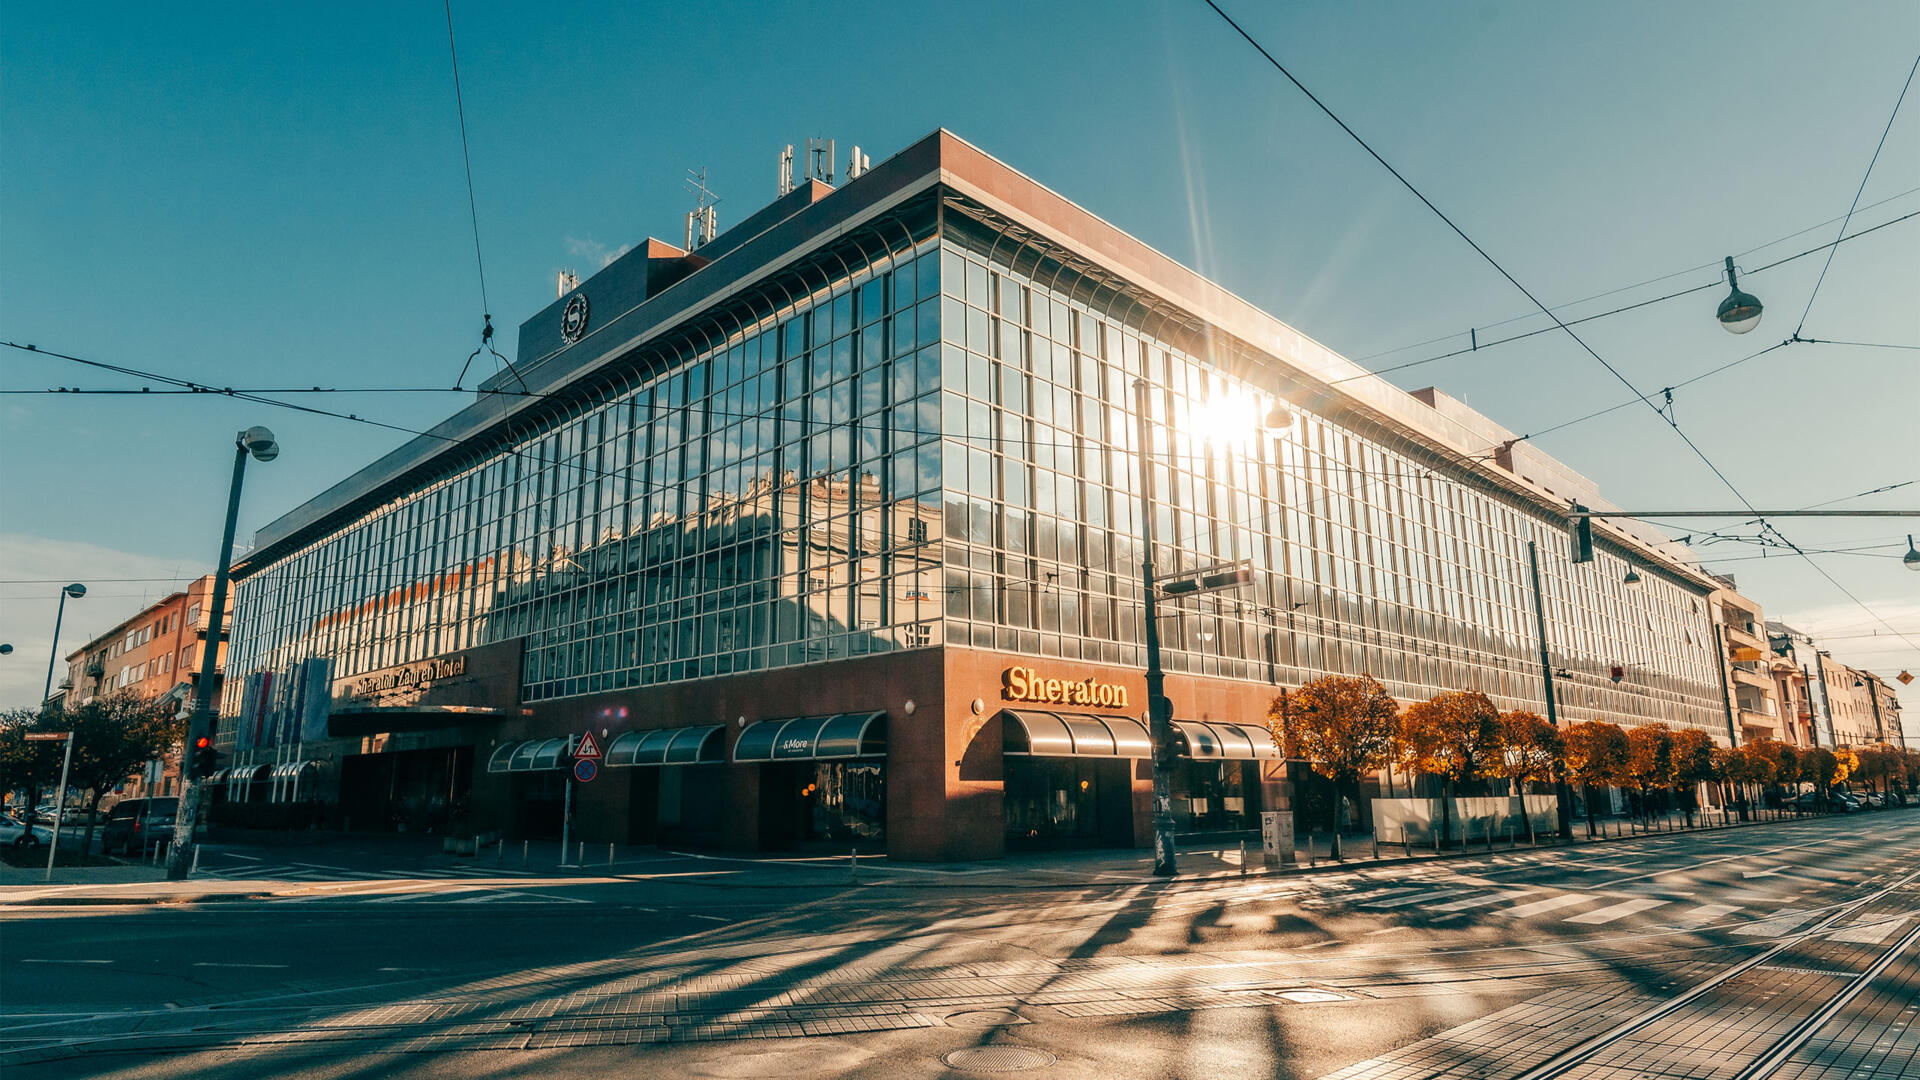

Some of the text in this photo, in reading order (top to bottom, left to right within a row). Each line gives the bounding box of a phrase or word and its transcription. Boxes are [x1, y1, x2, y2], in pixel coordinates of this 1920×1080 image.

[567, 302, 580, 333] S
[358, 674, 396, 694] Sheraton
[435, 655, 465, 680] Hotel
[1008, 666, 1129, 707] Sheraton
